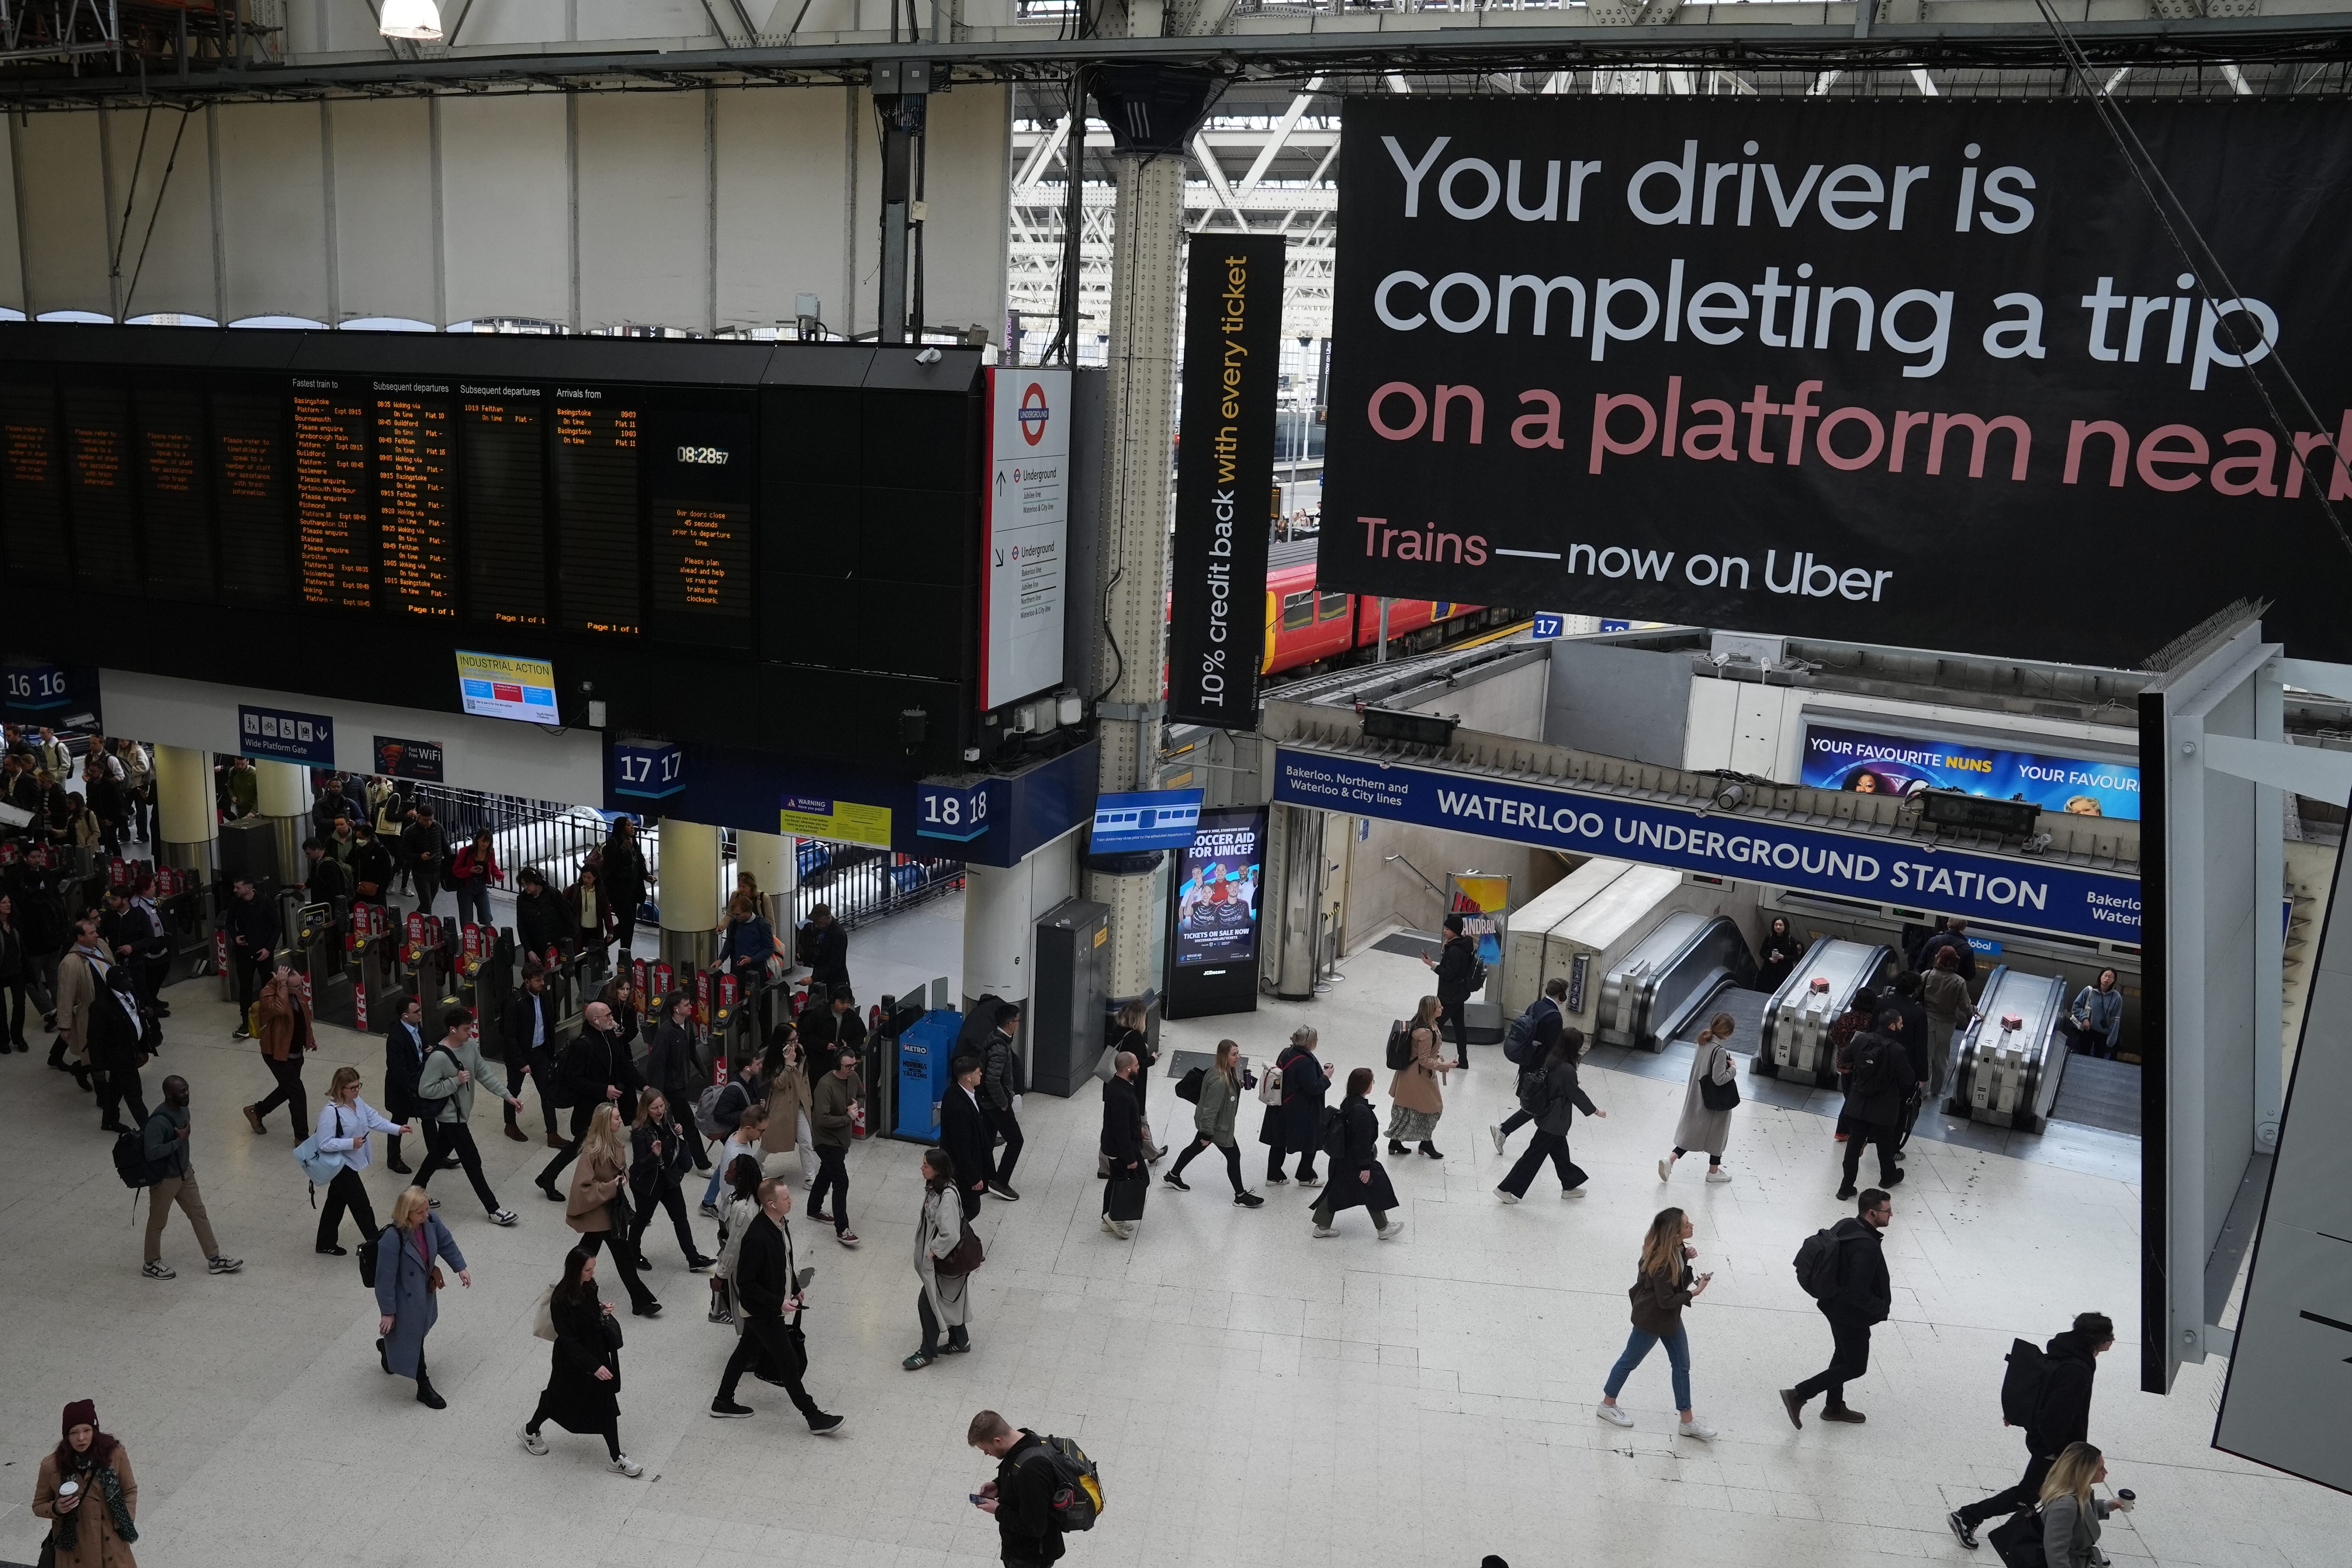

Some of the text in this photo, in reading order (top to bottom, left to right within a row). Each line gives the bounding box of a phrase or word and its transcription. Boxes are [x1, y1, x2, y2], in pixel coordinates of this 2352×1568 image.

[1381, 136, 2036, 234] Your driver is
[1375, 259, 2278, 390] completing a trip
[293, 379, 315, 387] Fastest
[373, 382, 449, 393] Subsequent departures
[460, 385, 540, 397] Subsequent departures
[557, 389, 601, 398] Arrivals from
[1020, 408, 1048, 420] UNDERGROUND
[1367, 381, 1484, 446] on
[1510, 387, 1565, 450] a
[1590, 374, 2031, 482] platform
[1024, 467, 1056, 482] Underground
[1202, 256, 1247, 706] 10% credit back with every ticket
[1022, 541, 1054, 557] Underground
[1358, 517, 1893, 601] Trains now on Uber
[1022, 568, 1035, 576] Bakerloo
[1021, 610, 1035, 618] Waterloo
[1537, 620, 1557, 634] 17
[460, 656, 513, 671] INDUSTRIAL
[516, 663, 549, 675] ACTION
[8, 674, 30, 696] 16
[39, 672, 65, 696] 16
[245, 738, 307, 754] Wide Platform Gate
[419, 749, 440, 761] WiFi
[1812, 738, 1991, 772] YOUR FAVOURITE NUNS
[621, 756, 651, 782] 17
[662, 752, 681, 781] 17
[2019, 765, 2064, 782] YOUR
[1287, 766, 1408, 794] Bakerloo, Northern and
[1291, 779, 1401, 805] Waterloo & City lines
[798, 799, 825, 807] WARNING
[925, 796, 959, 824] 18
[970, 791, 986, 823] 18
[1235, 832, 1255, 845] AID
[1189, 844, 1253, 858] FOR UNICEF
[1437, 789, 2047, 910] WATERLOO UNDERGROUND STATION
[217, 936, 227, 970] KFC
[1968, 939, 1991, 950] lobal
[356, 986, 366, 1022] KFC
[904, 1045, 926, 1054] METRO
